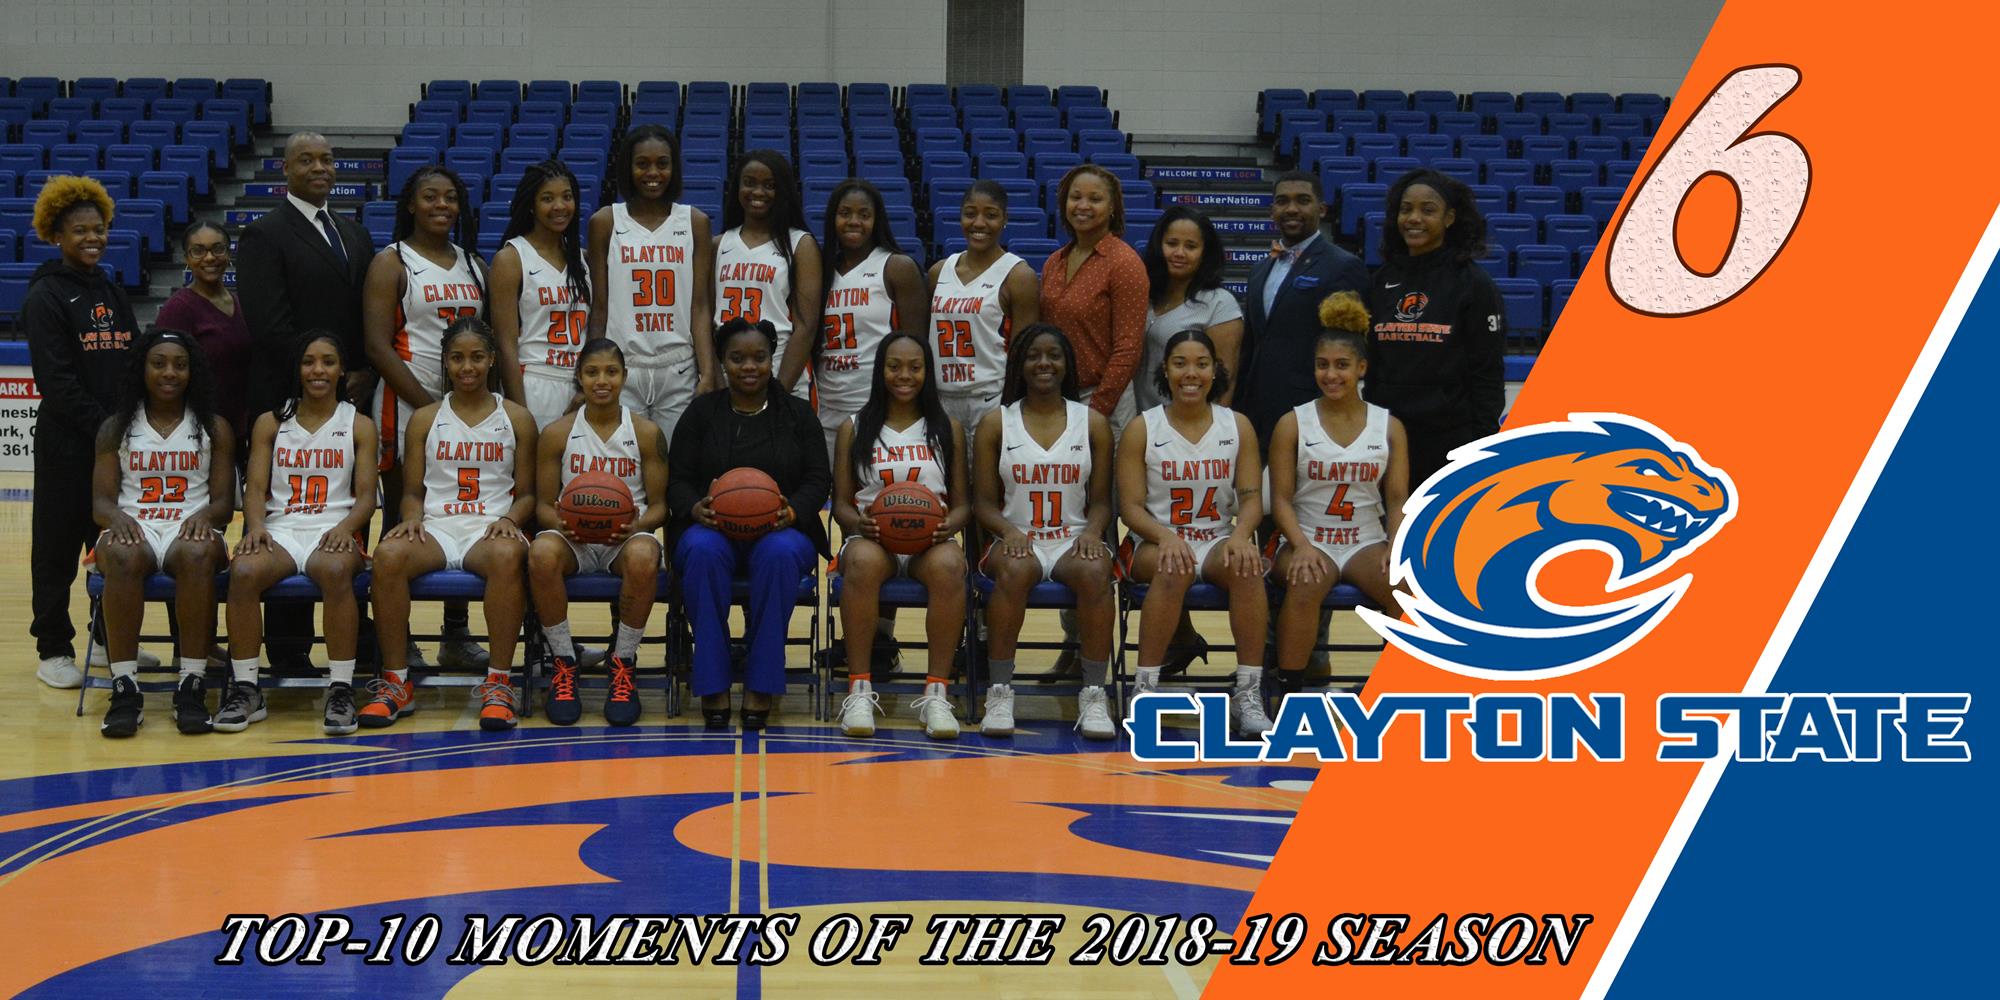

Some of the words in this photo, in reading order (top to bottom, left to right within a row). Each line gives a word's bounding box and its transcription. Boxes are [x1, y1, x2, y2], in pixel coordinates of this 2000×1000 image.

[1159, 170, 1198, 178] WELCOME
[1201, 170, 1212, 178] TO
[1215, 170, 1231, 178] THE
[1171, 195, 1260, 205] #CSULakerNation
[1249, 223, 1265, 231] THE
[621, 246, 684, 264] CLAYTON
[720, 262, 776, 284] CLAYTON
[423, 283, 481, 303] CLAYTO
[632, 269, 675, 307] 30
[827, 287, 869, 308] AYTON
[721, 287, 763, 324] 33
[547, 310, 587, 346] 20
[635, 312, 674, 332] STATE
[823, 312, 857, 350] 21
[1487, 314, 1501, 332] 3
[936, 319, 976, 357] 22
[1377, 332, 1444, 342] BASKETBALL
[942, 363, 976, 382] STATE
[0, 406, 38, 419] nesb
[129, 450, 200, 471] CLAYTON
[277, 447, 344, 468] CLAYTON
[436, 440, 504, 462] CLAYTON
[570, 453, 637, 478] CLAYTON
[1012, 463, 1080, 485] CLAYTON
[1161, 459, 1230, 481] CLAYTON
[1308, 460, 1380, 481] CLAYTON
[287, 474, 329, 506] 10
[457, 468, 480, 501] 5
[443, 502, 487, 516] STATE
[572, 493, 620, 509] Wilson
[883, 494, 932, 509] Wilson
[1029, 491, 1063, 529] 11
[1170, 486, 1221, 526] 24
[1324, 483, 1355, 522] 4
[137, 507, 184, 521] STATE
[1314, 526, 1360, 545] STATE
